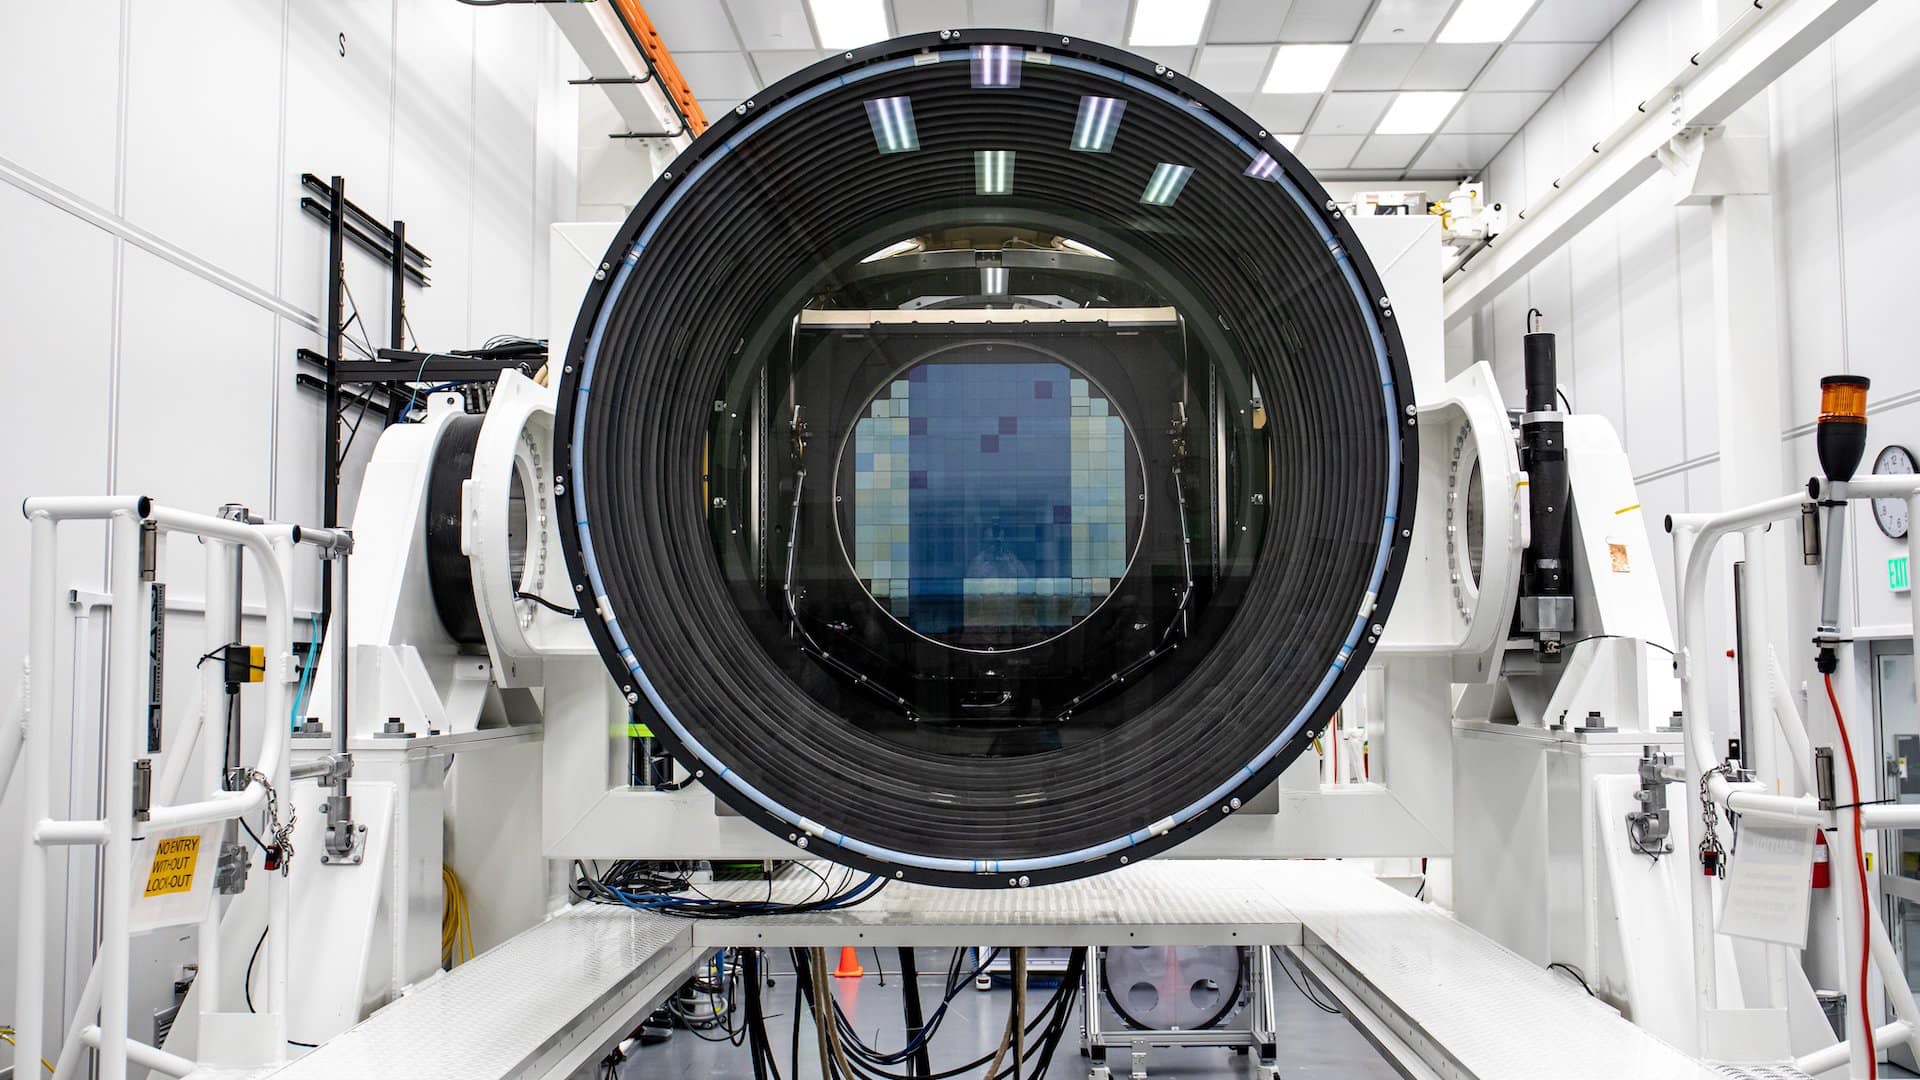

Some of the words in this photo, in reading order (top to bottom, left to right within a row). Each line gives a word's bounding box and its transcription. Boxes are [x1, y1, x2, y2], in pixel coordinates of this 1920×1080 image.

[338, 31, 346, 58] S
[1888, 557, 1908, 589] EXIT
[157, 842, 170, 855] NO
[170, 838, 198, 853] ENTRY
[152, 857, 190, 873] WITHOUT
[146, 874, 192, 892] LOCK-OUT
